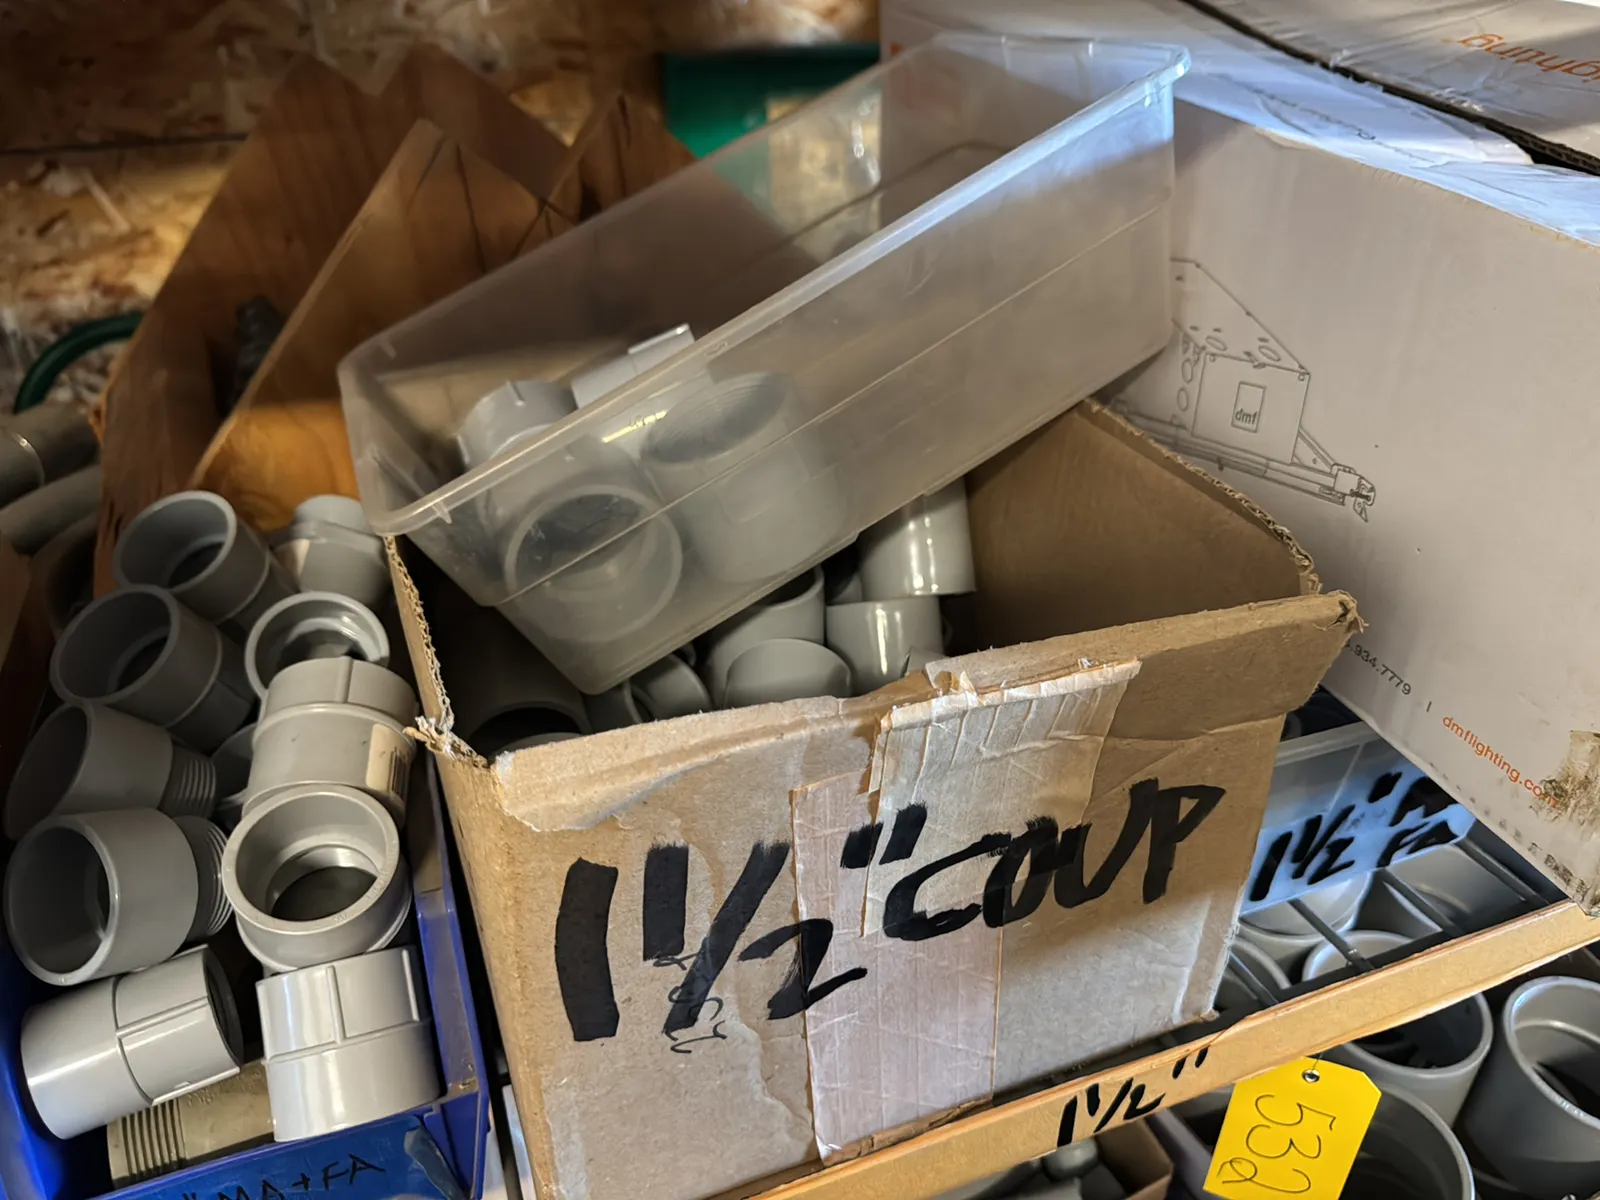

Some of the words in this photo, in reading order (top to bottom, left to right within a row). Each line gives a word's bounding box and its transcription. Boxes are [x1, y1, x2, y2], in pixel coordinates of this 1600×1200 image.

[1235, 408, 1258, 424] dmf
[1347, 644, 1412, 695] .934.7779
[1216, 1094, 1336, 1194] 532
